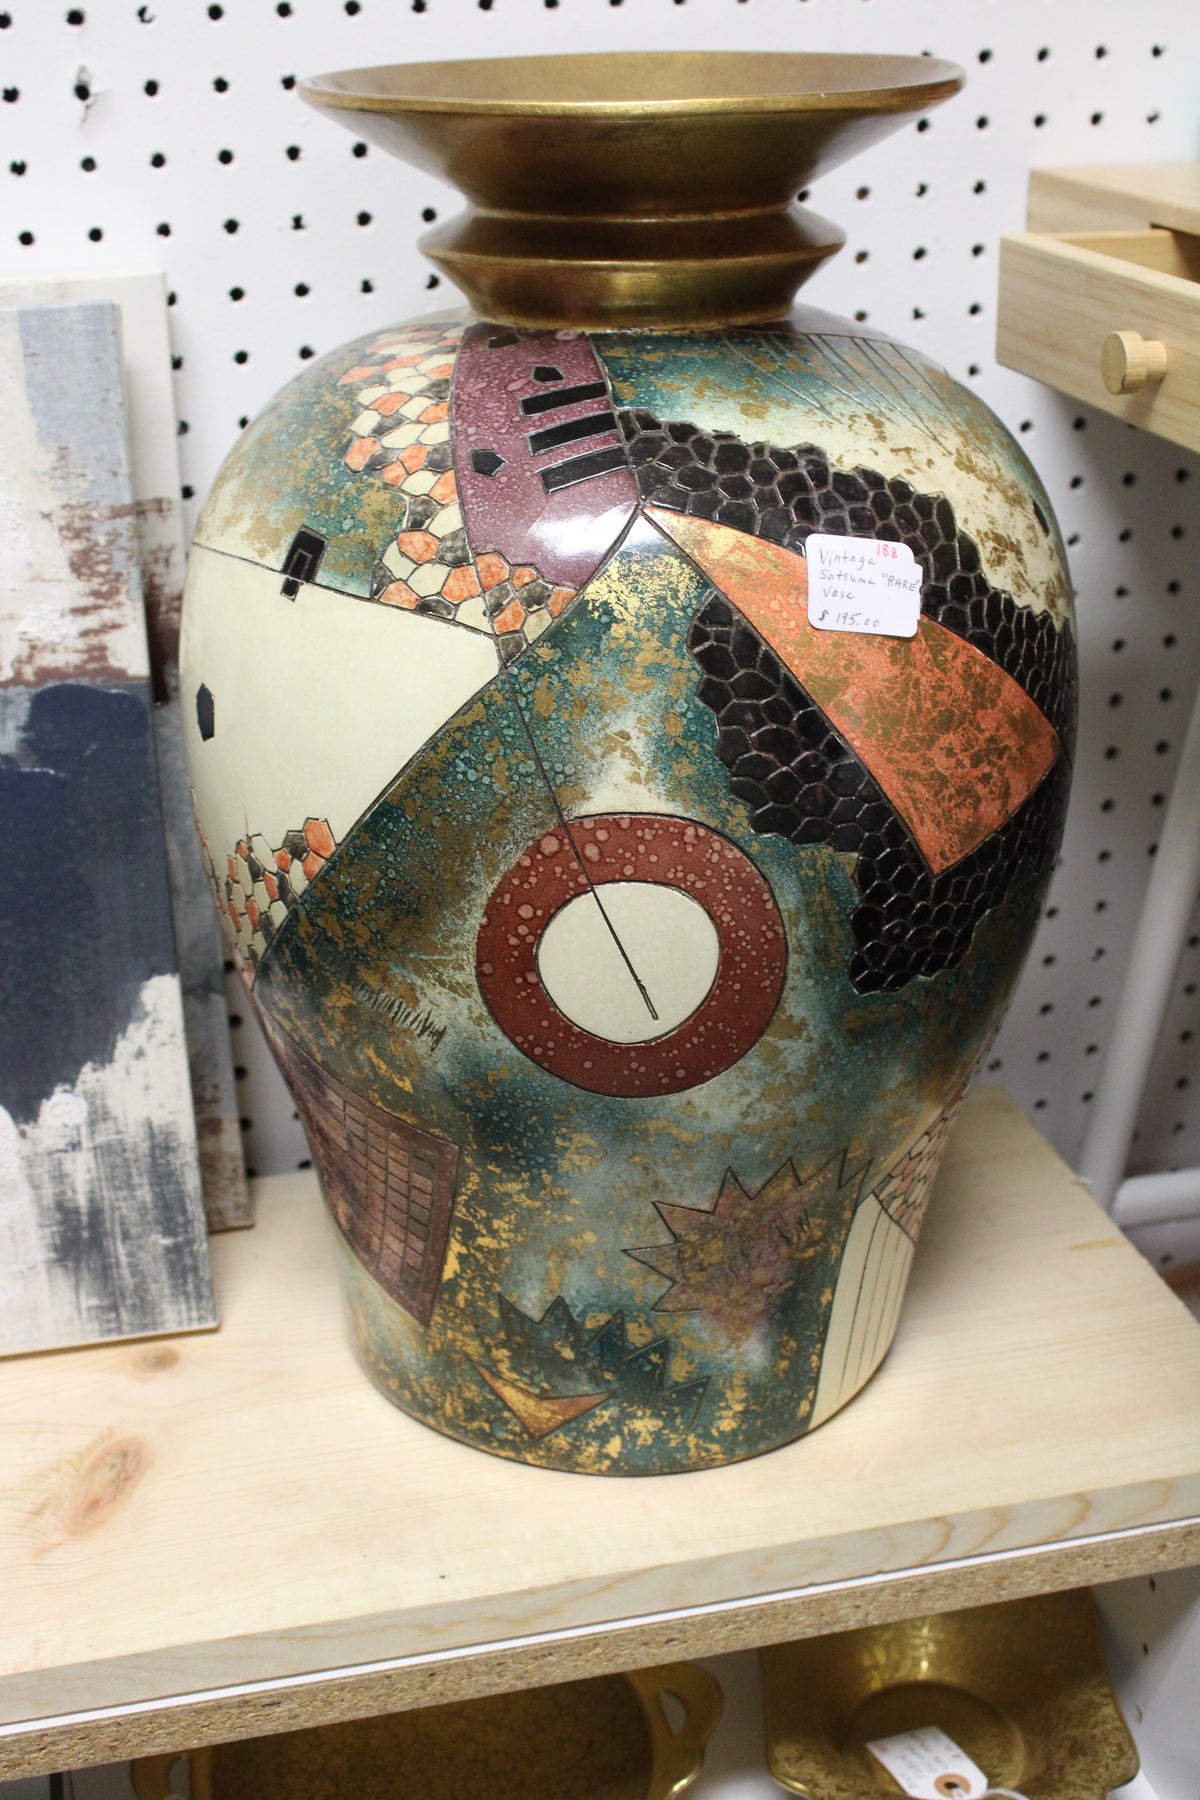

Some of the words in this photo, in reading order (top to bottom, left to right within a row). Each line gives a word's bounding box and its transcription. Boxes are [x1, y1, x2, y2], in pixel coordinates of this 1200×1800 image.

[877, 543, 898, 559] 188
[819, 548, 876, 571] Vintage
[823, 587, 855, 600] Vase
